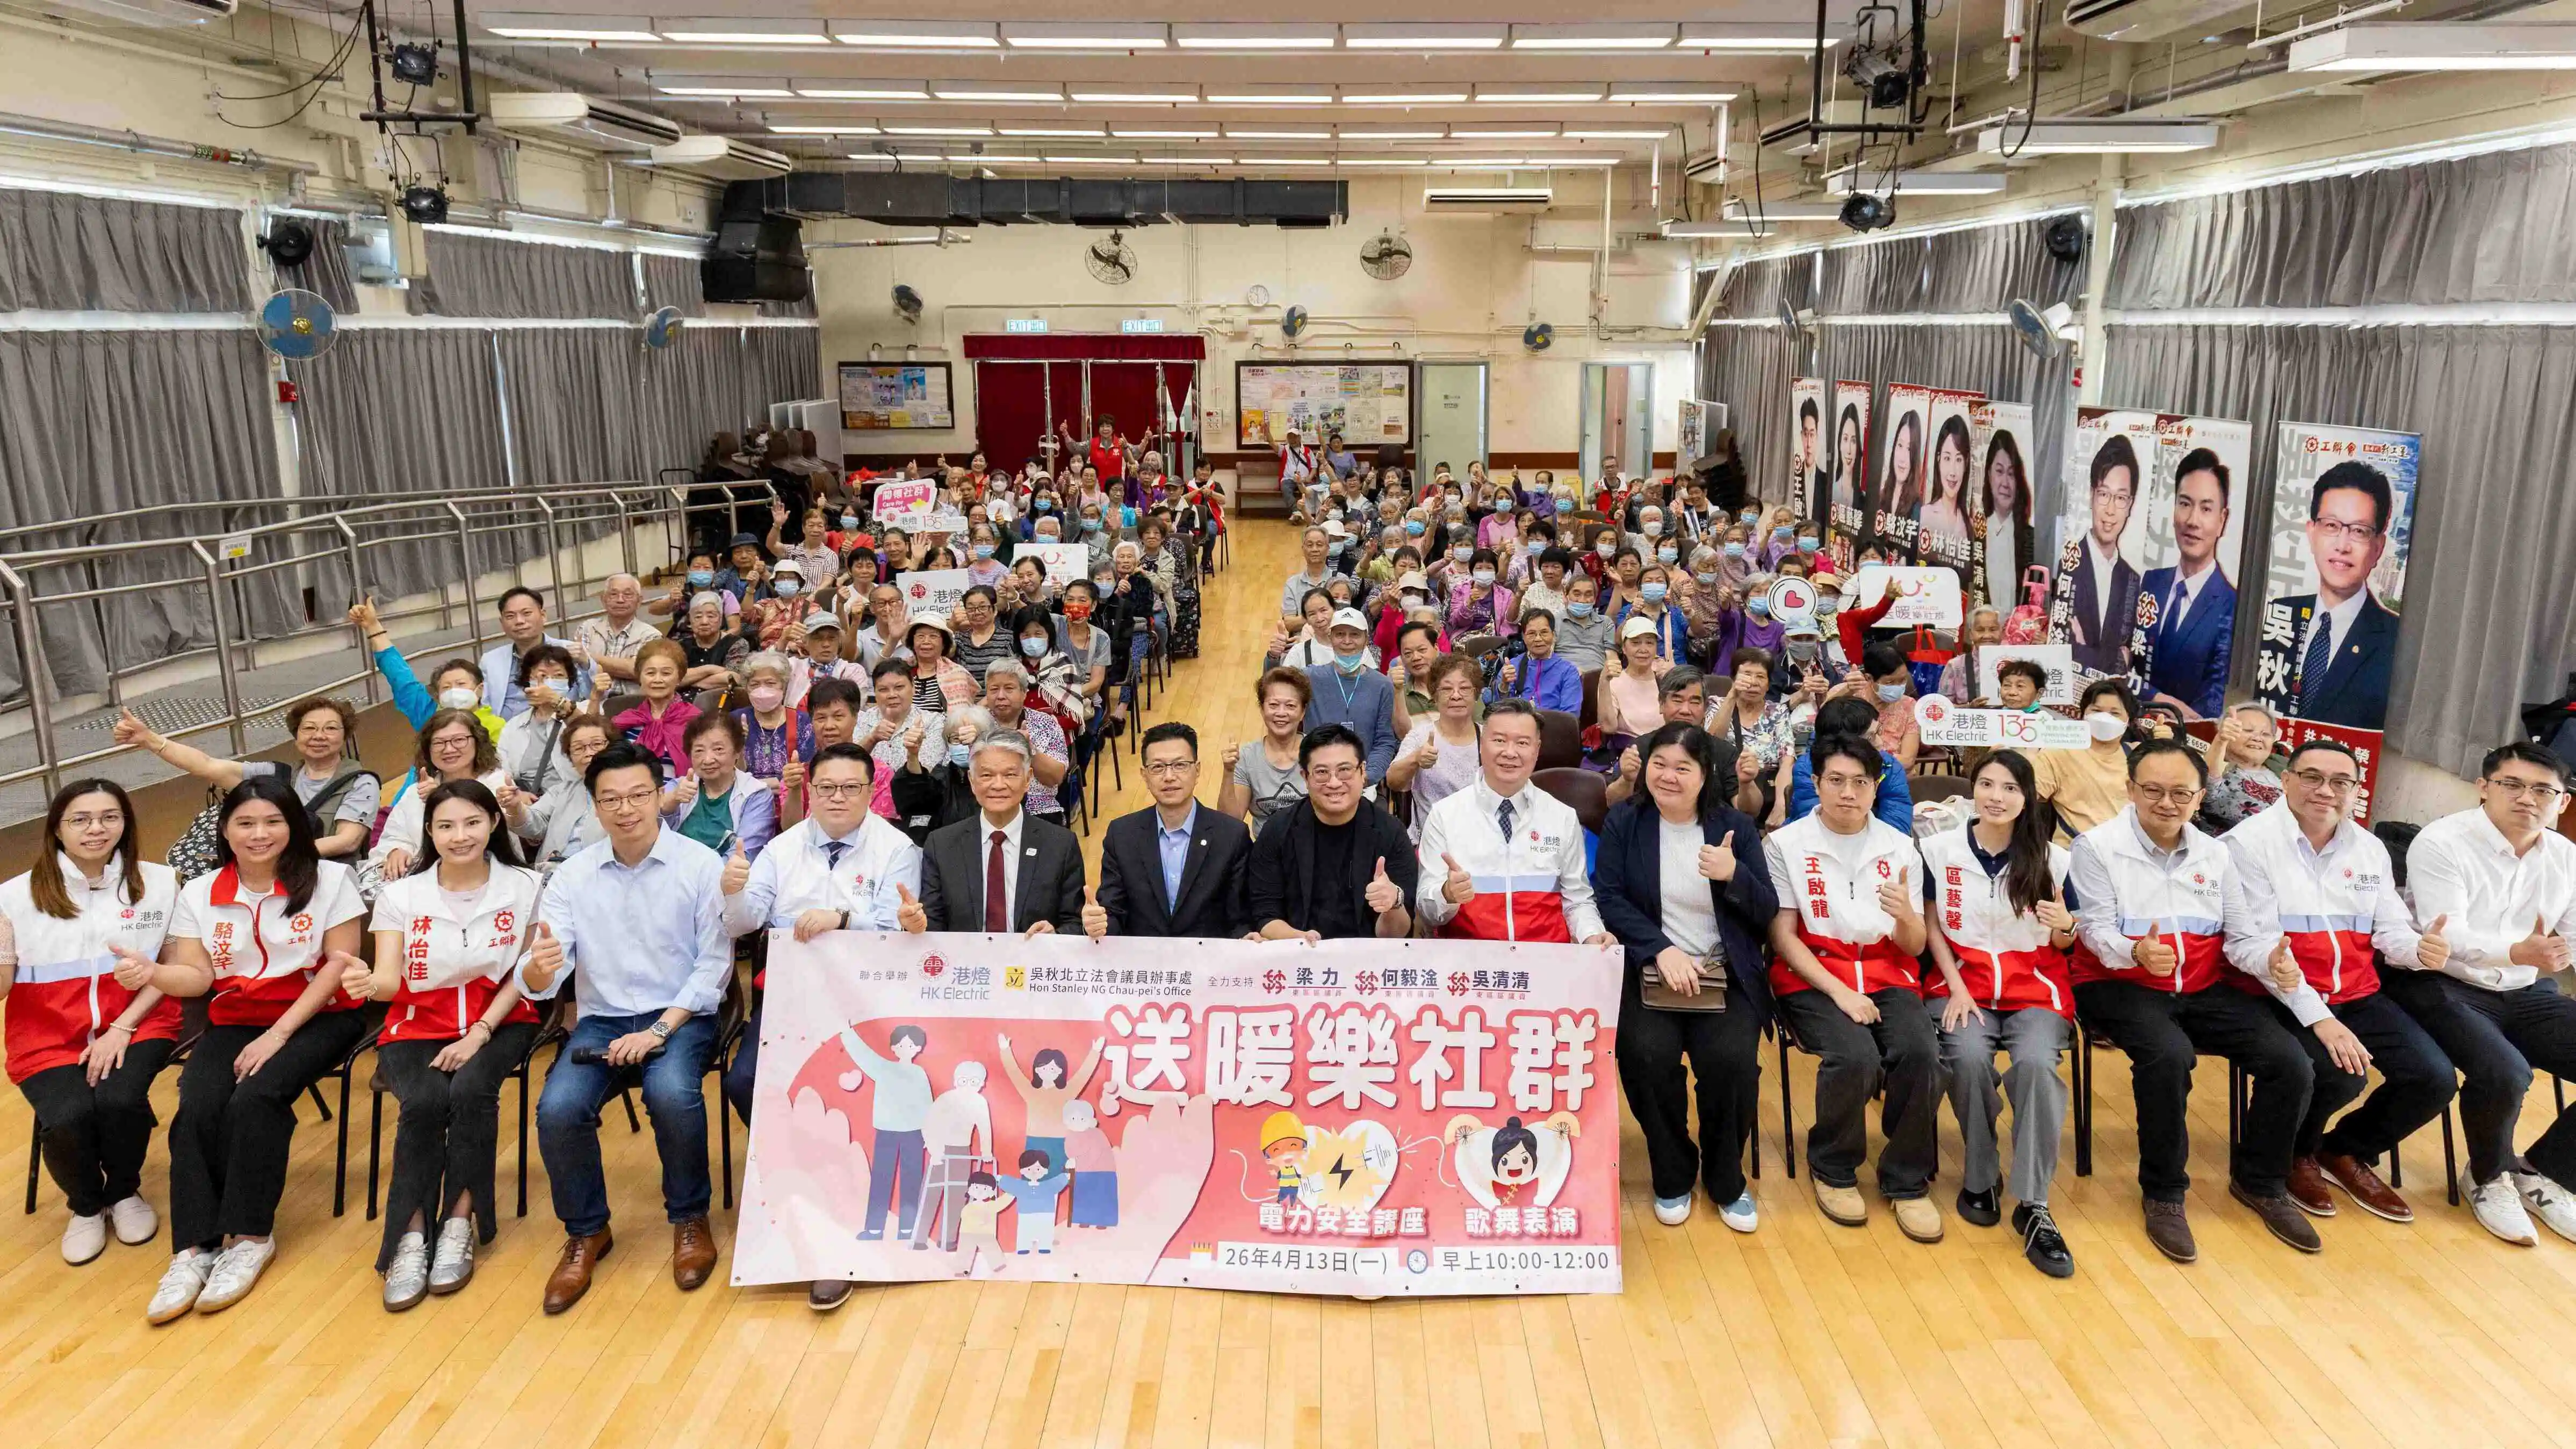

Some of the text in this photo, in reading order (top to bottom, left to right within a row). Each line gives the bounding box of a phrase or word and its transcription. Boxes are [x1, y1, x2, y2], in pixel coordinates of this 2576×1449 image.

[1009, 320, 1046, 331] EXIT 出口
[1124, 320, 1161, 331] EXIT 出口
[1794, 475, 1803, 522] 王啟
[1926, 730, 1988, 742] HK Electric
[1952, 713, 1988, 730] 港燈
[1998, 715, 2037, 742] 135
[1805, 857, 1830, 919] 王啟龍
[212, 921, 234, 970] 駱汶芊
[408, 915, 432, 981] 林怡佳
[860, 970, 908, 982] 聯合舉辦
[951, 966, 991, 985] 港燈
[1030, 967, 1193, 986] 吳秋北立法會議員辦事處
[1208, 976, 1254, 987] 全力支持
[1296, 967, 1339, 986] 梁力
[1382, 968, 1439, 987] 何毅淦
[1472, 970, 1530, 990] 吳清清
[921, 986, 990, 1000] HK Electric
[1029, 983, 1192, 998] Hon Stanley NG Chau-pei's Office
[1105, 1008, 1598, 1112] 送暖樂社群
[1259, 1203, 1427, 1235] 電力安全講座
[1465, 1206, 1578, 1235] 歌舞表演
[1225, 1248, 1388, 1275] 26年4月13日(一)
[1442, 1251, 1610, 1271] 早上10:00-12:00
